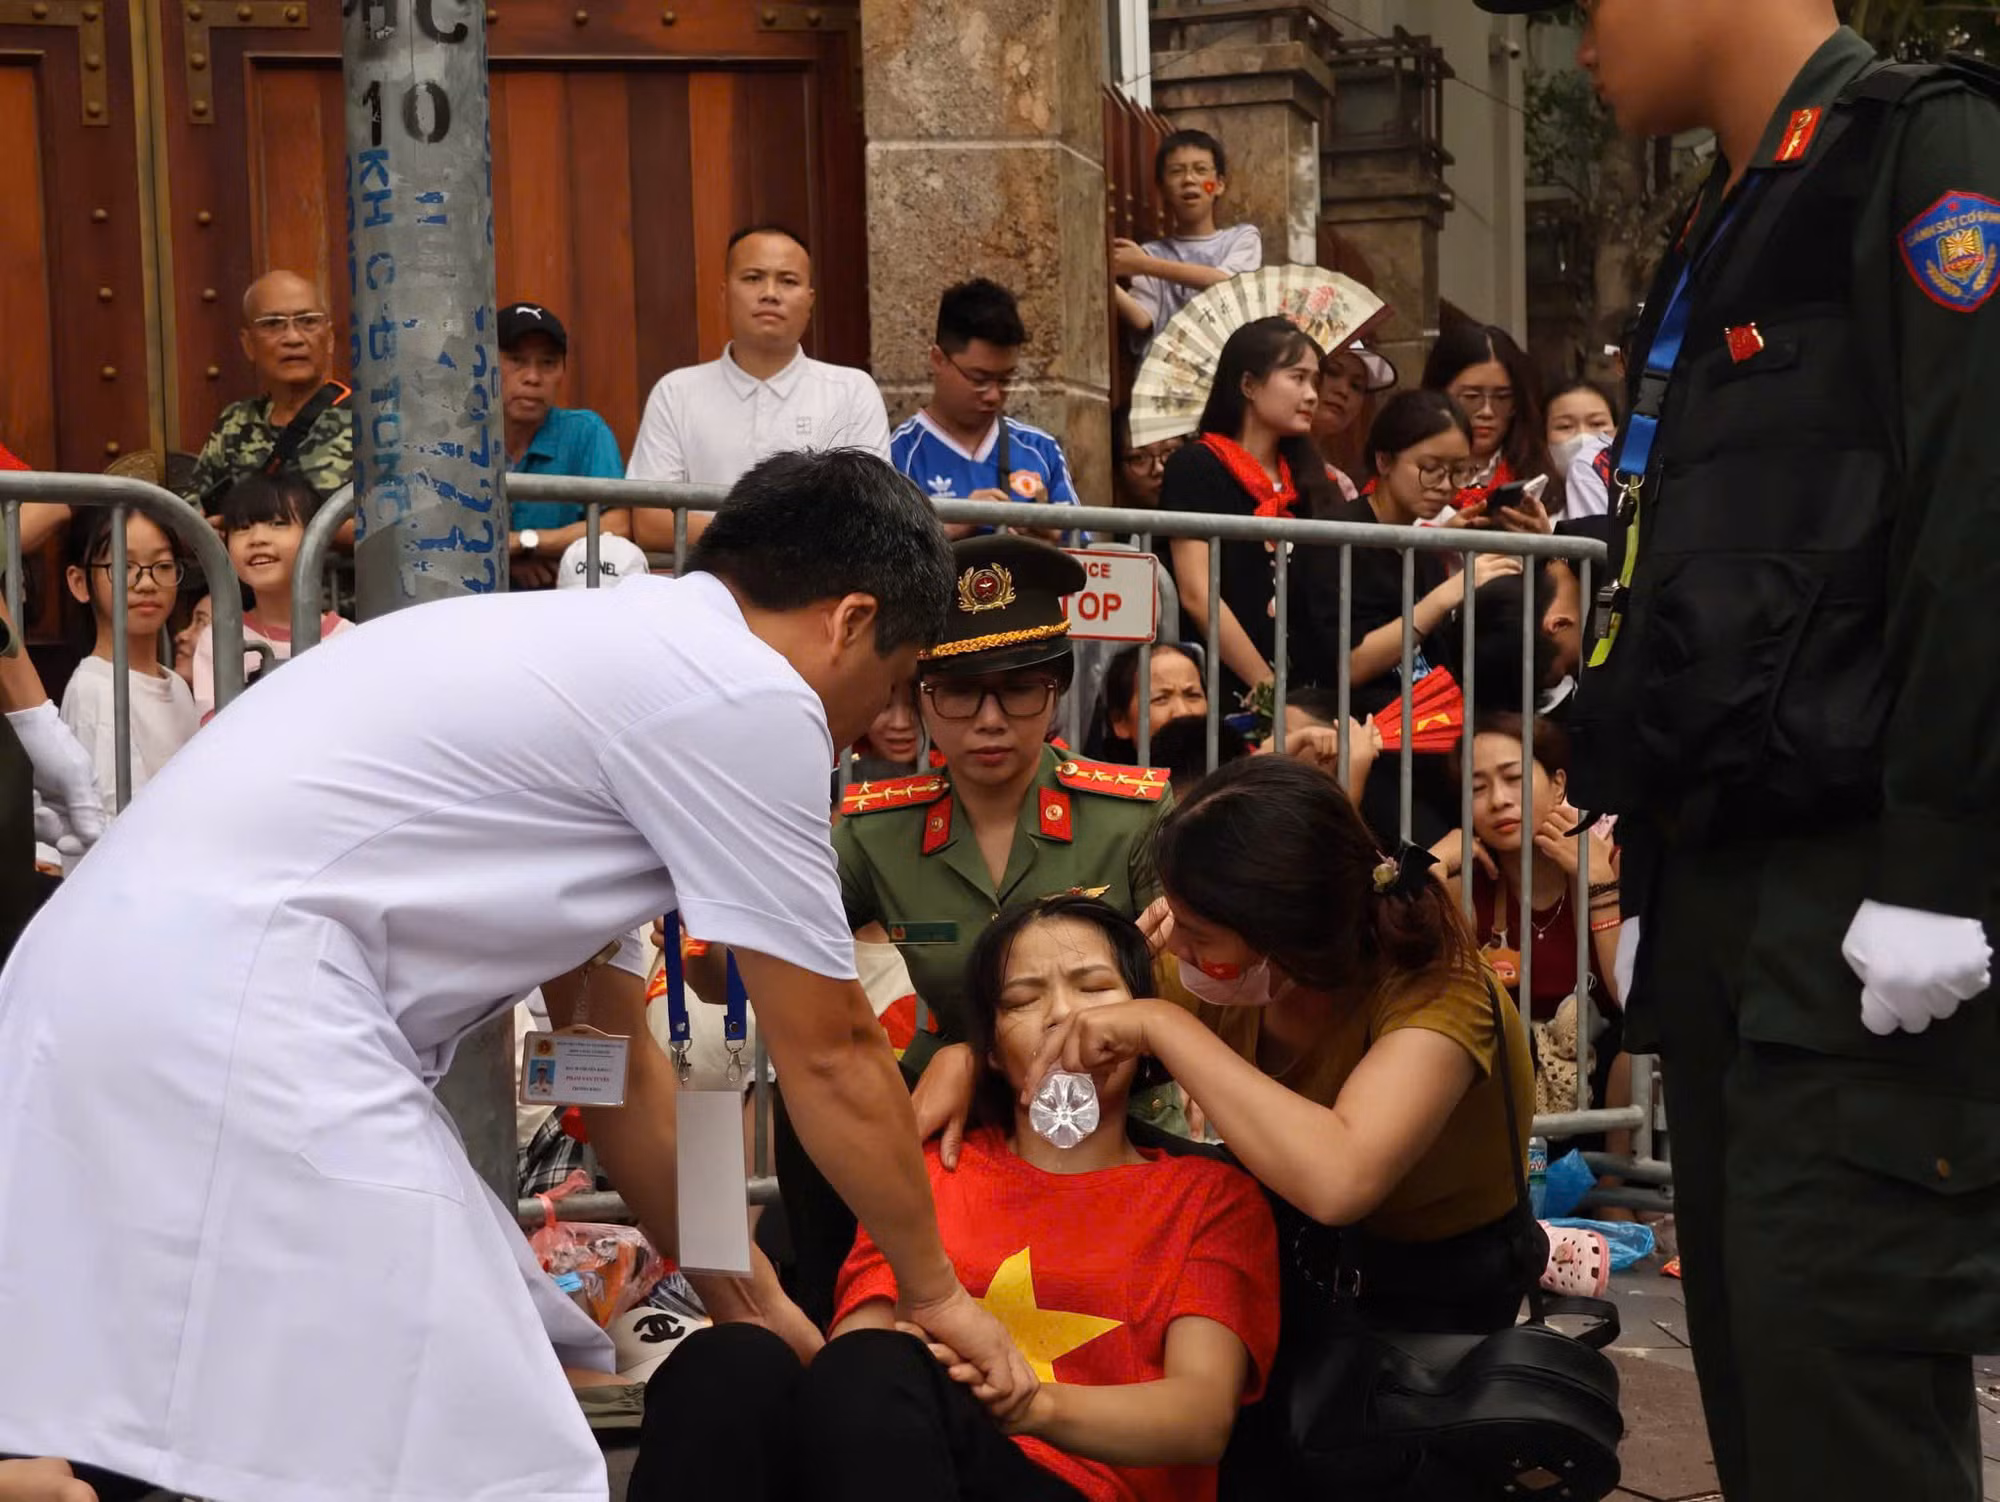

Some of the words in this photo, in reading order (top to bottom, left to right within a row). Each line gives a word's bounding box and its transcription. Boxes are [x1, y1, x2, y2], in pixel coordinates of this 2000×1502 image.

[362, 81, 450, 146] 10
[575, 561, 619, 577] CHNEL
[1061, 591, 1122, 621] TOP
